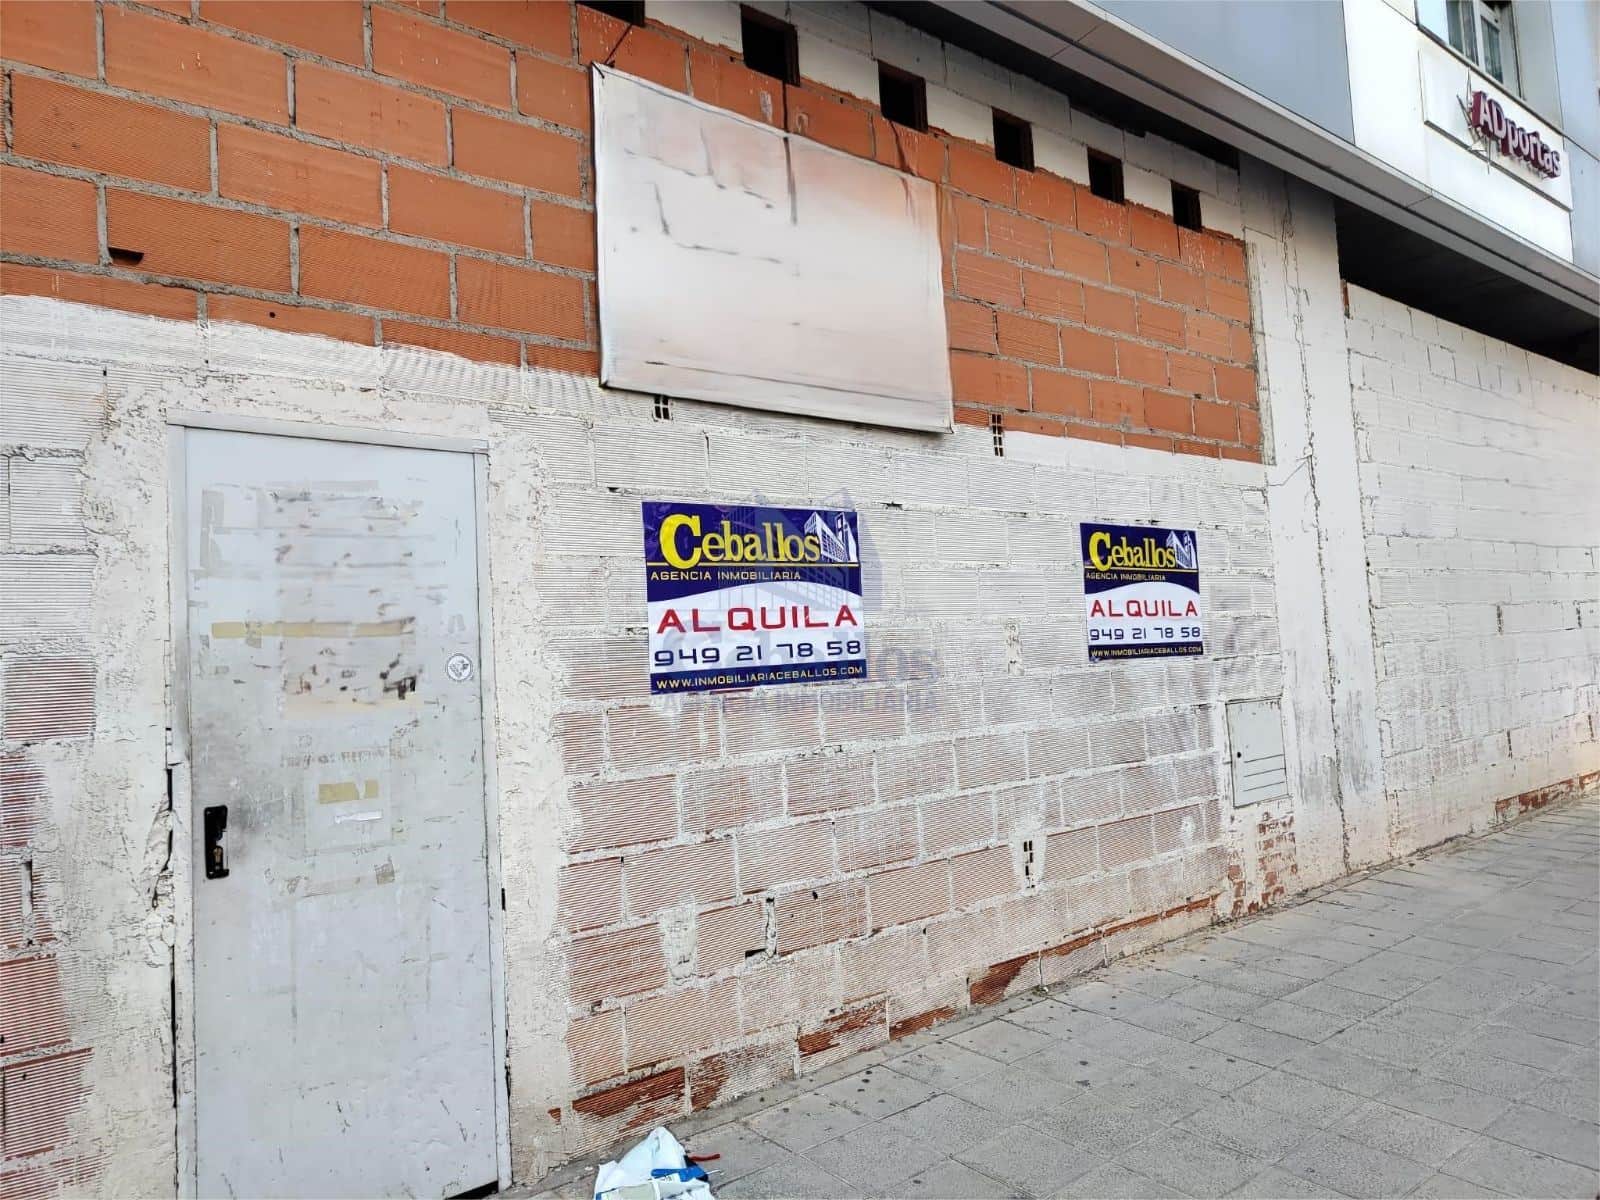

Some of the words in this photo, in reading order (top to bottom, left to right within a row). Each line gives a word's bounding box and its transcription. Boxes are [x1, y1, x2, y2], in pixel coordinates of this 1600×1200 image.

[1471, 90, 1561, 179] ADportas
[659, 513, 820, 569] Ceballos
[1088, 531, 1176, 571] Ceballos
[650, 571, 712, 581] AGENCIA
[717, 571, 801, 580] INMOBILIARIA
[1086, 572, 1118, 581] AGENCIA
[1120, 573, 1166, 581] INMOBILIARIA
[656, 604, 858, 634] ALQUILA
[1090, 599, 1198, 618] ALQUILA
[1089, 627, 1124, 641] 949
[1132, 627, 1147, 640] 21
[1154, 627, 1174, 639] 78
[1181, 626, 1201, 638] 58
[654, 646, 721, 668] 949
[736, 644, 762, 661] 21
[776, 642, 814, 658] 78
[827, 640, 862, 656] 58
[1091, 645, 1202, 657] WWW.INMOBILIARIACEBALLOS.COM
[656, 665, 863, 689] WWW.INMOBILIARIACEBALLOS.COM
